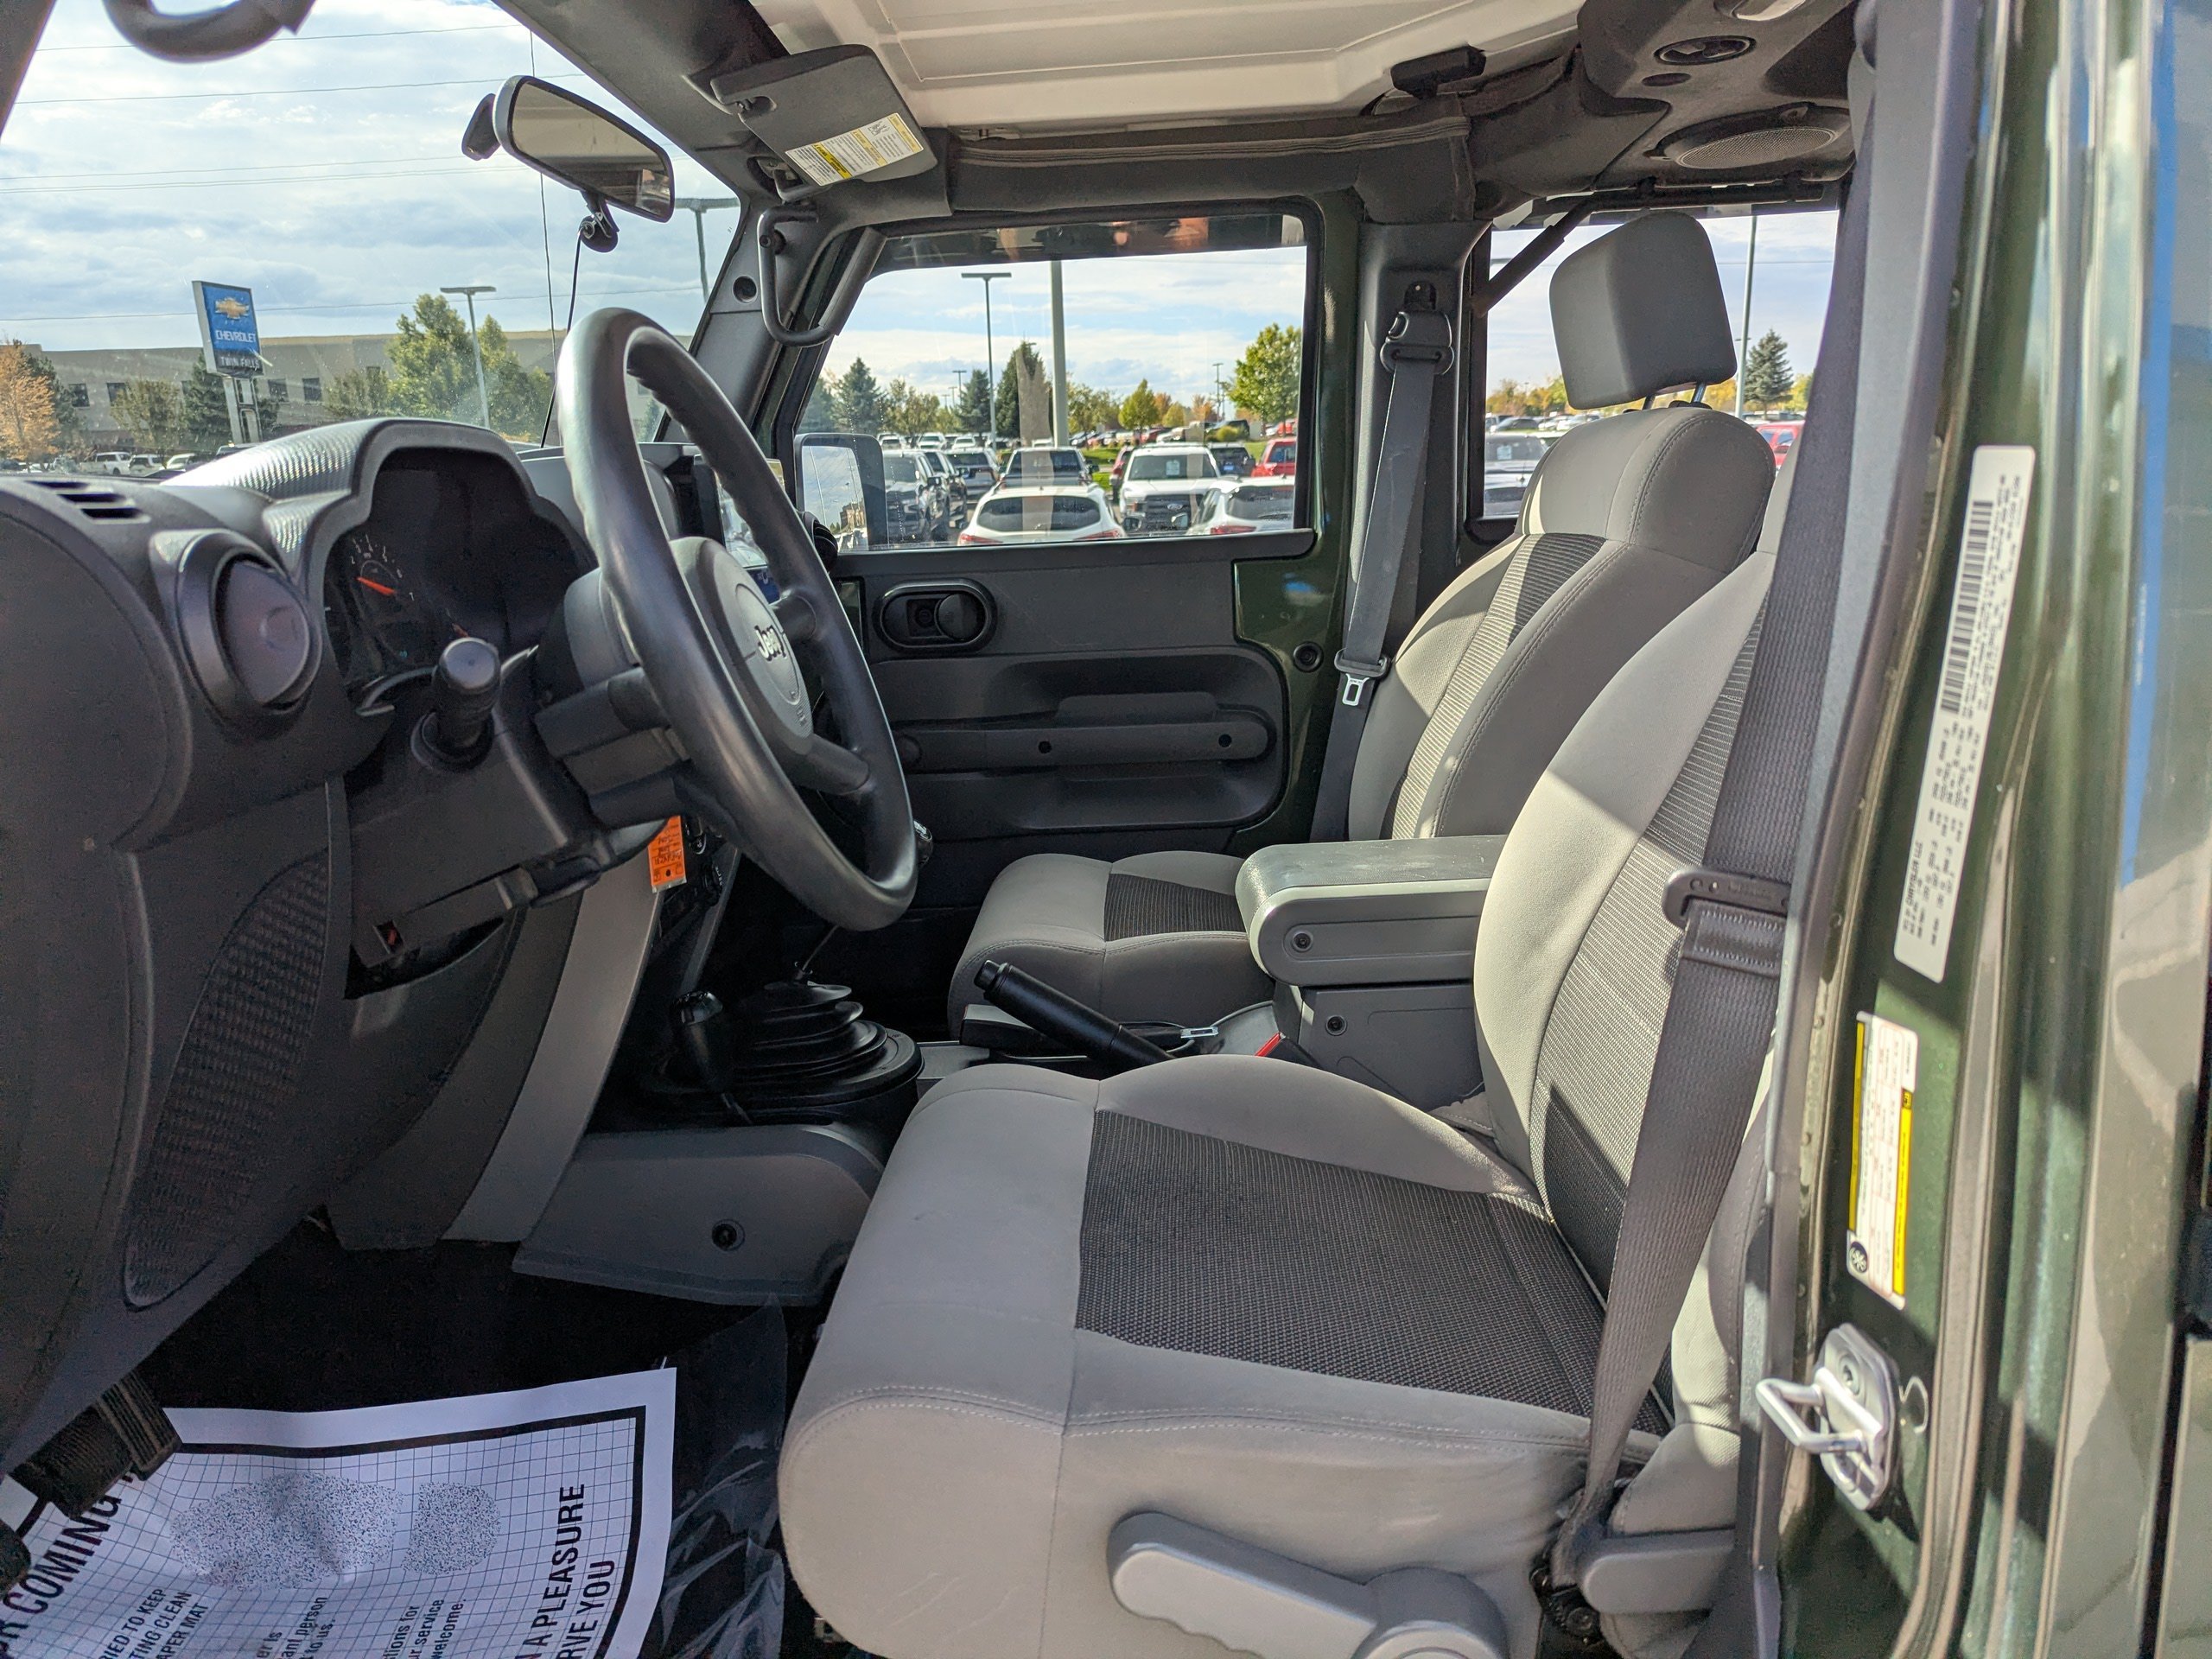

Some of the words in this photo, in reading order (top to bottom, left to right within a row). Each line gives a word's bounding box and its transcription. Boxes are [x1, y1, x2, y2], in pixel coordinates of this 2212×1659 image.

[215, 329, 257, 343] CHEVROLET
[240, 356, 260, 369] FALLS
[3, 1495, 122, 1614] COMING
[531, 1484, 584, 1629] PLEASURE
[575, 1560, 615, 1615] YOU
[122, 1616, 145, 1632] TO
[137, 1589, 167, 1615] KEEP
[154, 1592, 192, 1629] CLEAN
[180, 1603, 208, 1629] MAT
[295, 1597, 328, 1636] person
[399, 1606, 420, 1622] for
[415, 1599, 444, 1645] service
[523, 1633, 553, 1647] A
[556, 1619, 598, 1659] RVE
